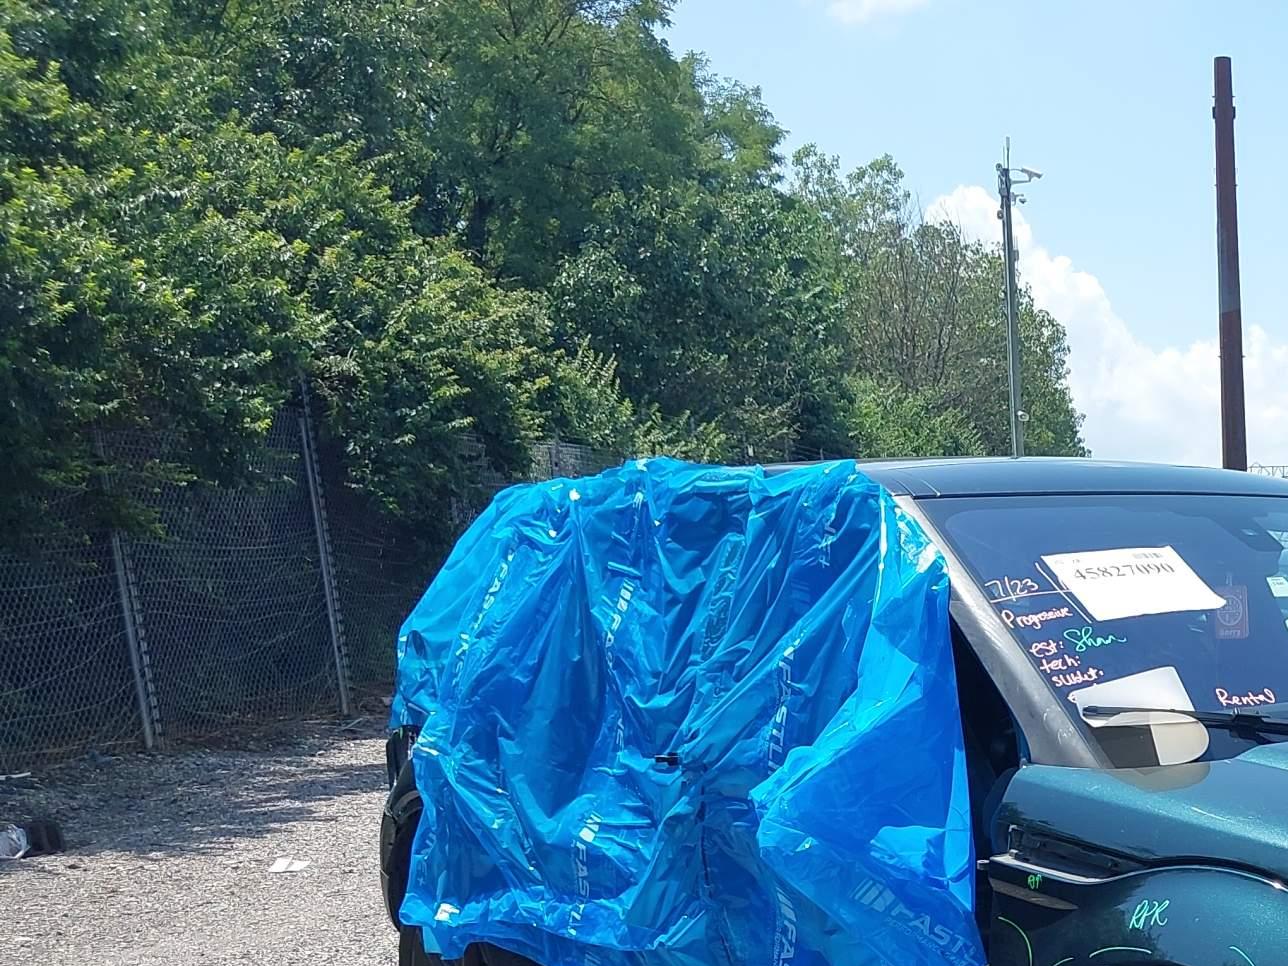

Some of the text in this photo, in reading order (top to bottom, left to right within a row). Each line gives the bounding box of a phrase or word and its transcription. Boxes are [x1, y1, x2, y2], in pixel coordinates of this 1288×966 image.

[1075, 563, 1175, 580] 45827090
[985, 576, 1039, 602] 7/23
[1216, 687, 1275, 706] Rental
